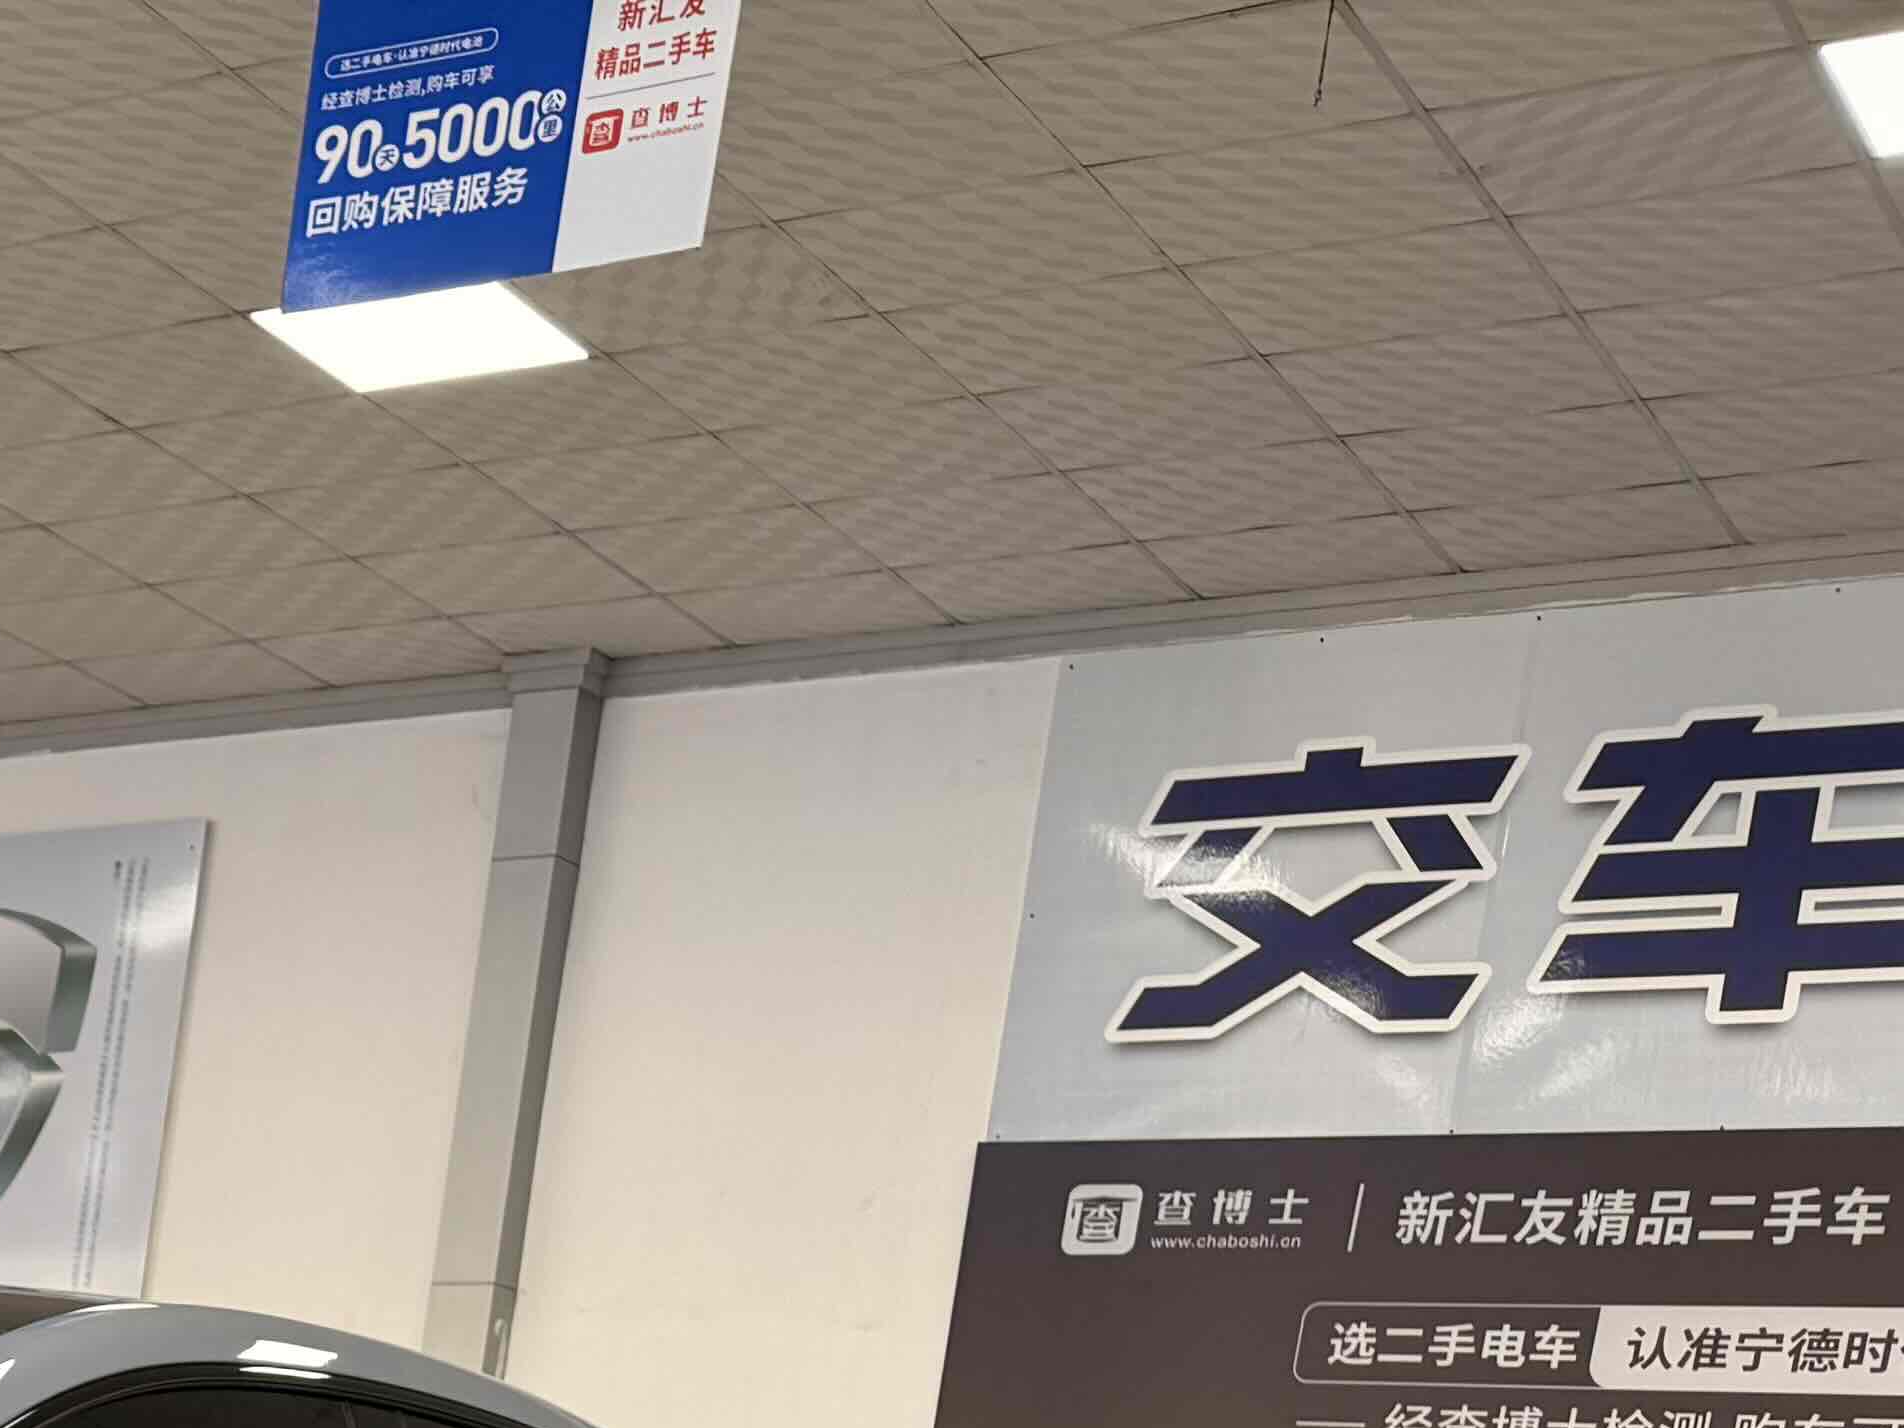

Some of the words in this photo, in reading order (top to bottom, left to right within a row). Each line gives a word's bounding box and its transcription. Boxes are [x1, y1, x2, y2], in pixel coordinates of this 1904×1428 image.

[594, 27, 718, 81] 精品二手车
[304, 166, 530, 239] 回购保障服务
[1106, 706, 1904, 1042] 交车
[1153, 1188, 1310, 1226] 查博士
[1393, 1186, 1892, 1249] 新汇友精品二手车
[1149, 1233, 1303, 1250] www.chaboshi.cn
[1326, 1320, 1582, 1371] 选二手电车
[1626, 1325, 1904, 1374] 认准宁德时
